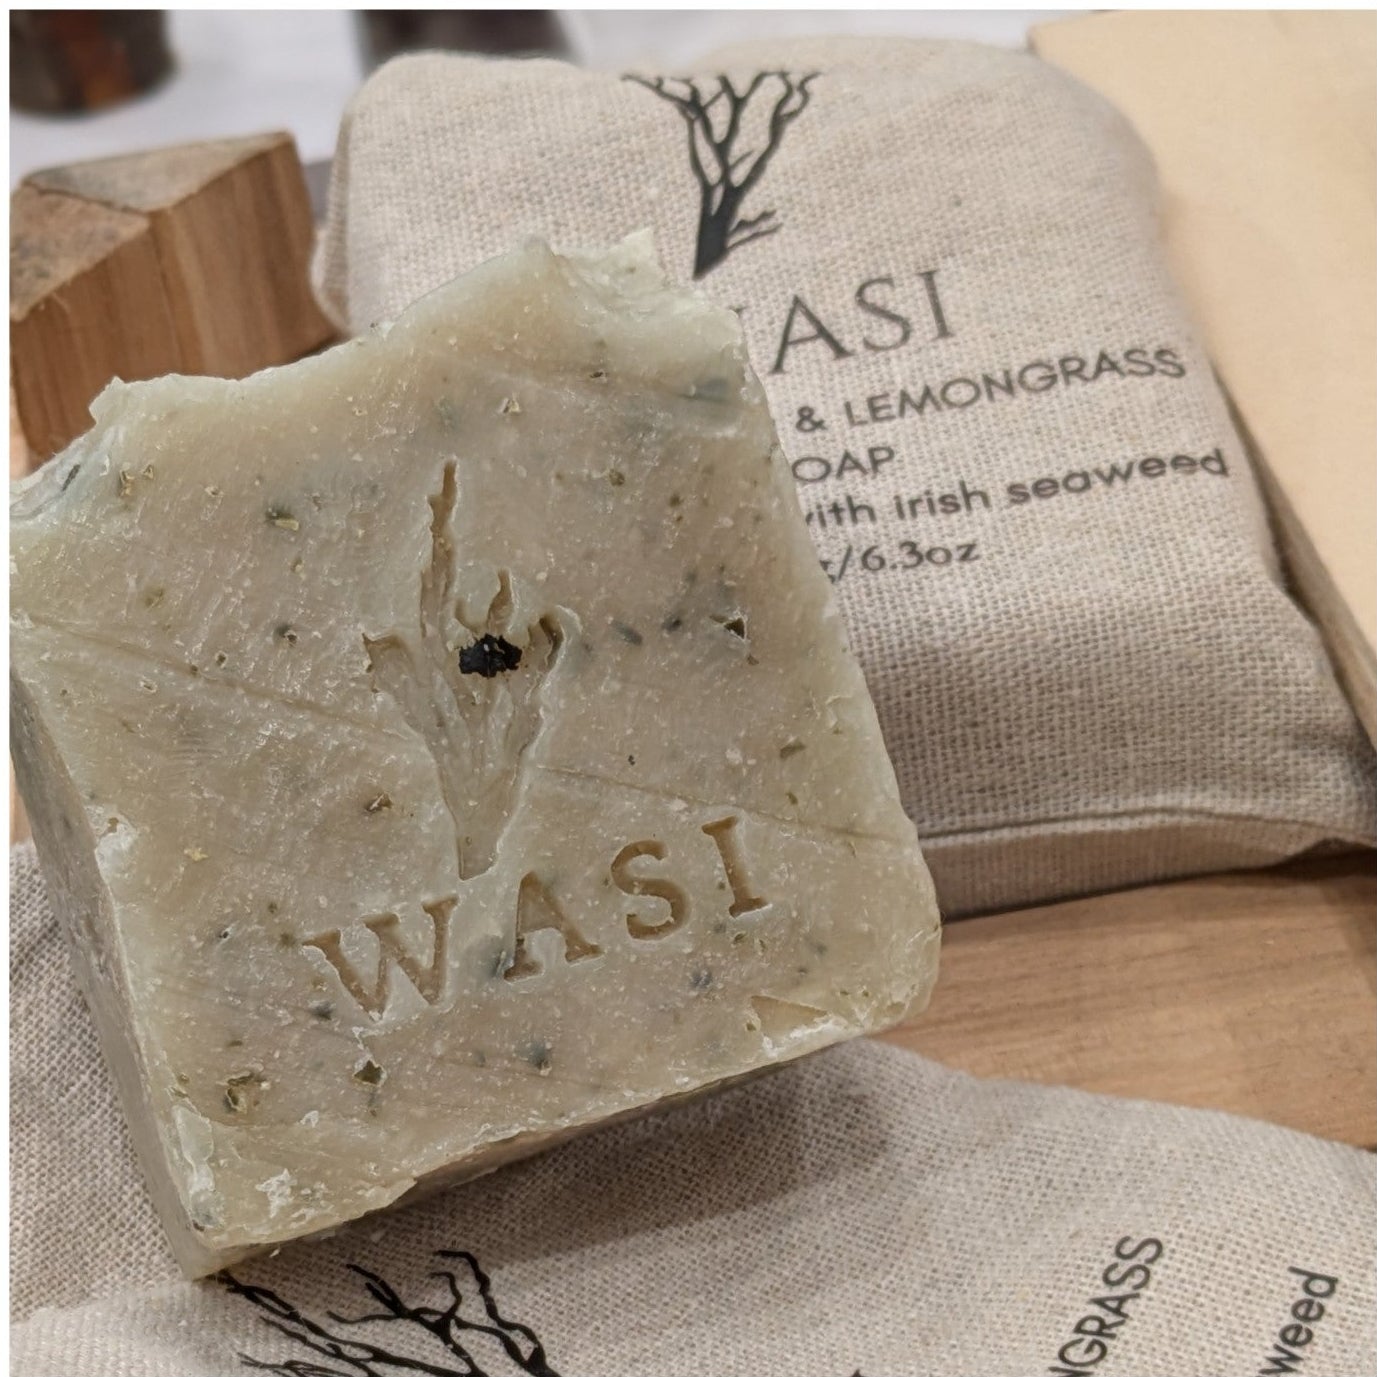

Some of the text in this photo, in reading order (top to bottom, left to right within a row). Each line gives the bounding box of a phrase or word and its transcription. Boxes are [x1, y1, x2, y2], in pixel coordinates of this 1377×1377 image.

[730, 269, 954, 375] ASI
[795, 346, 1187, 433] & LEMONGRASS
[790, 445, 896, 484] OAP
[893, 478, 993, 521] irish
[1007, 447, 1230, 508] seaweed
[302, 815, 775, 1023] WASI
